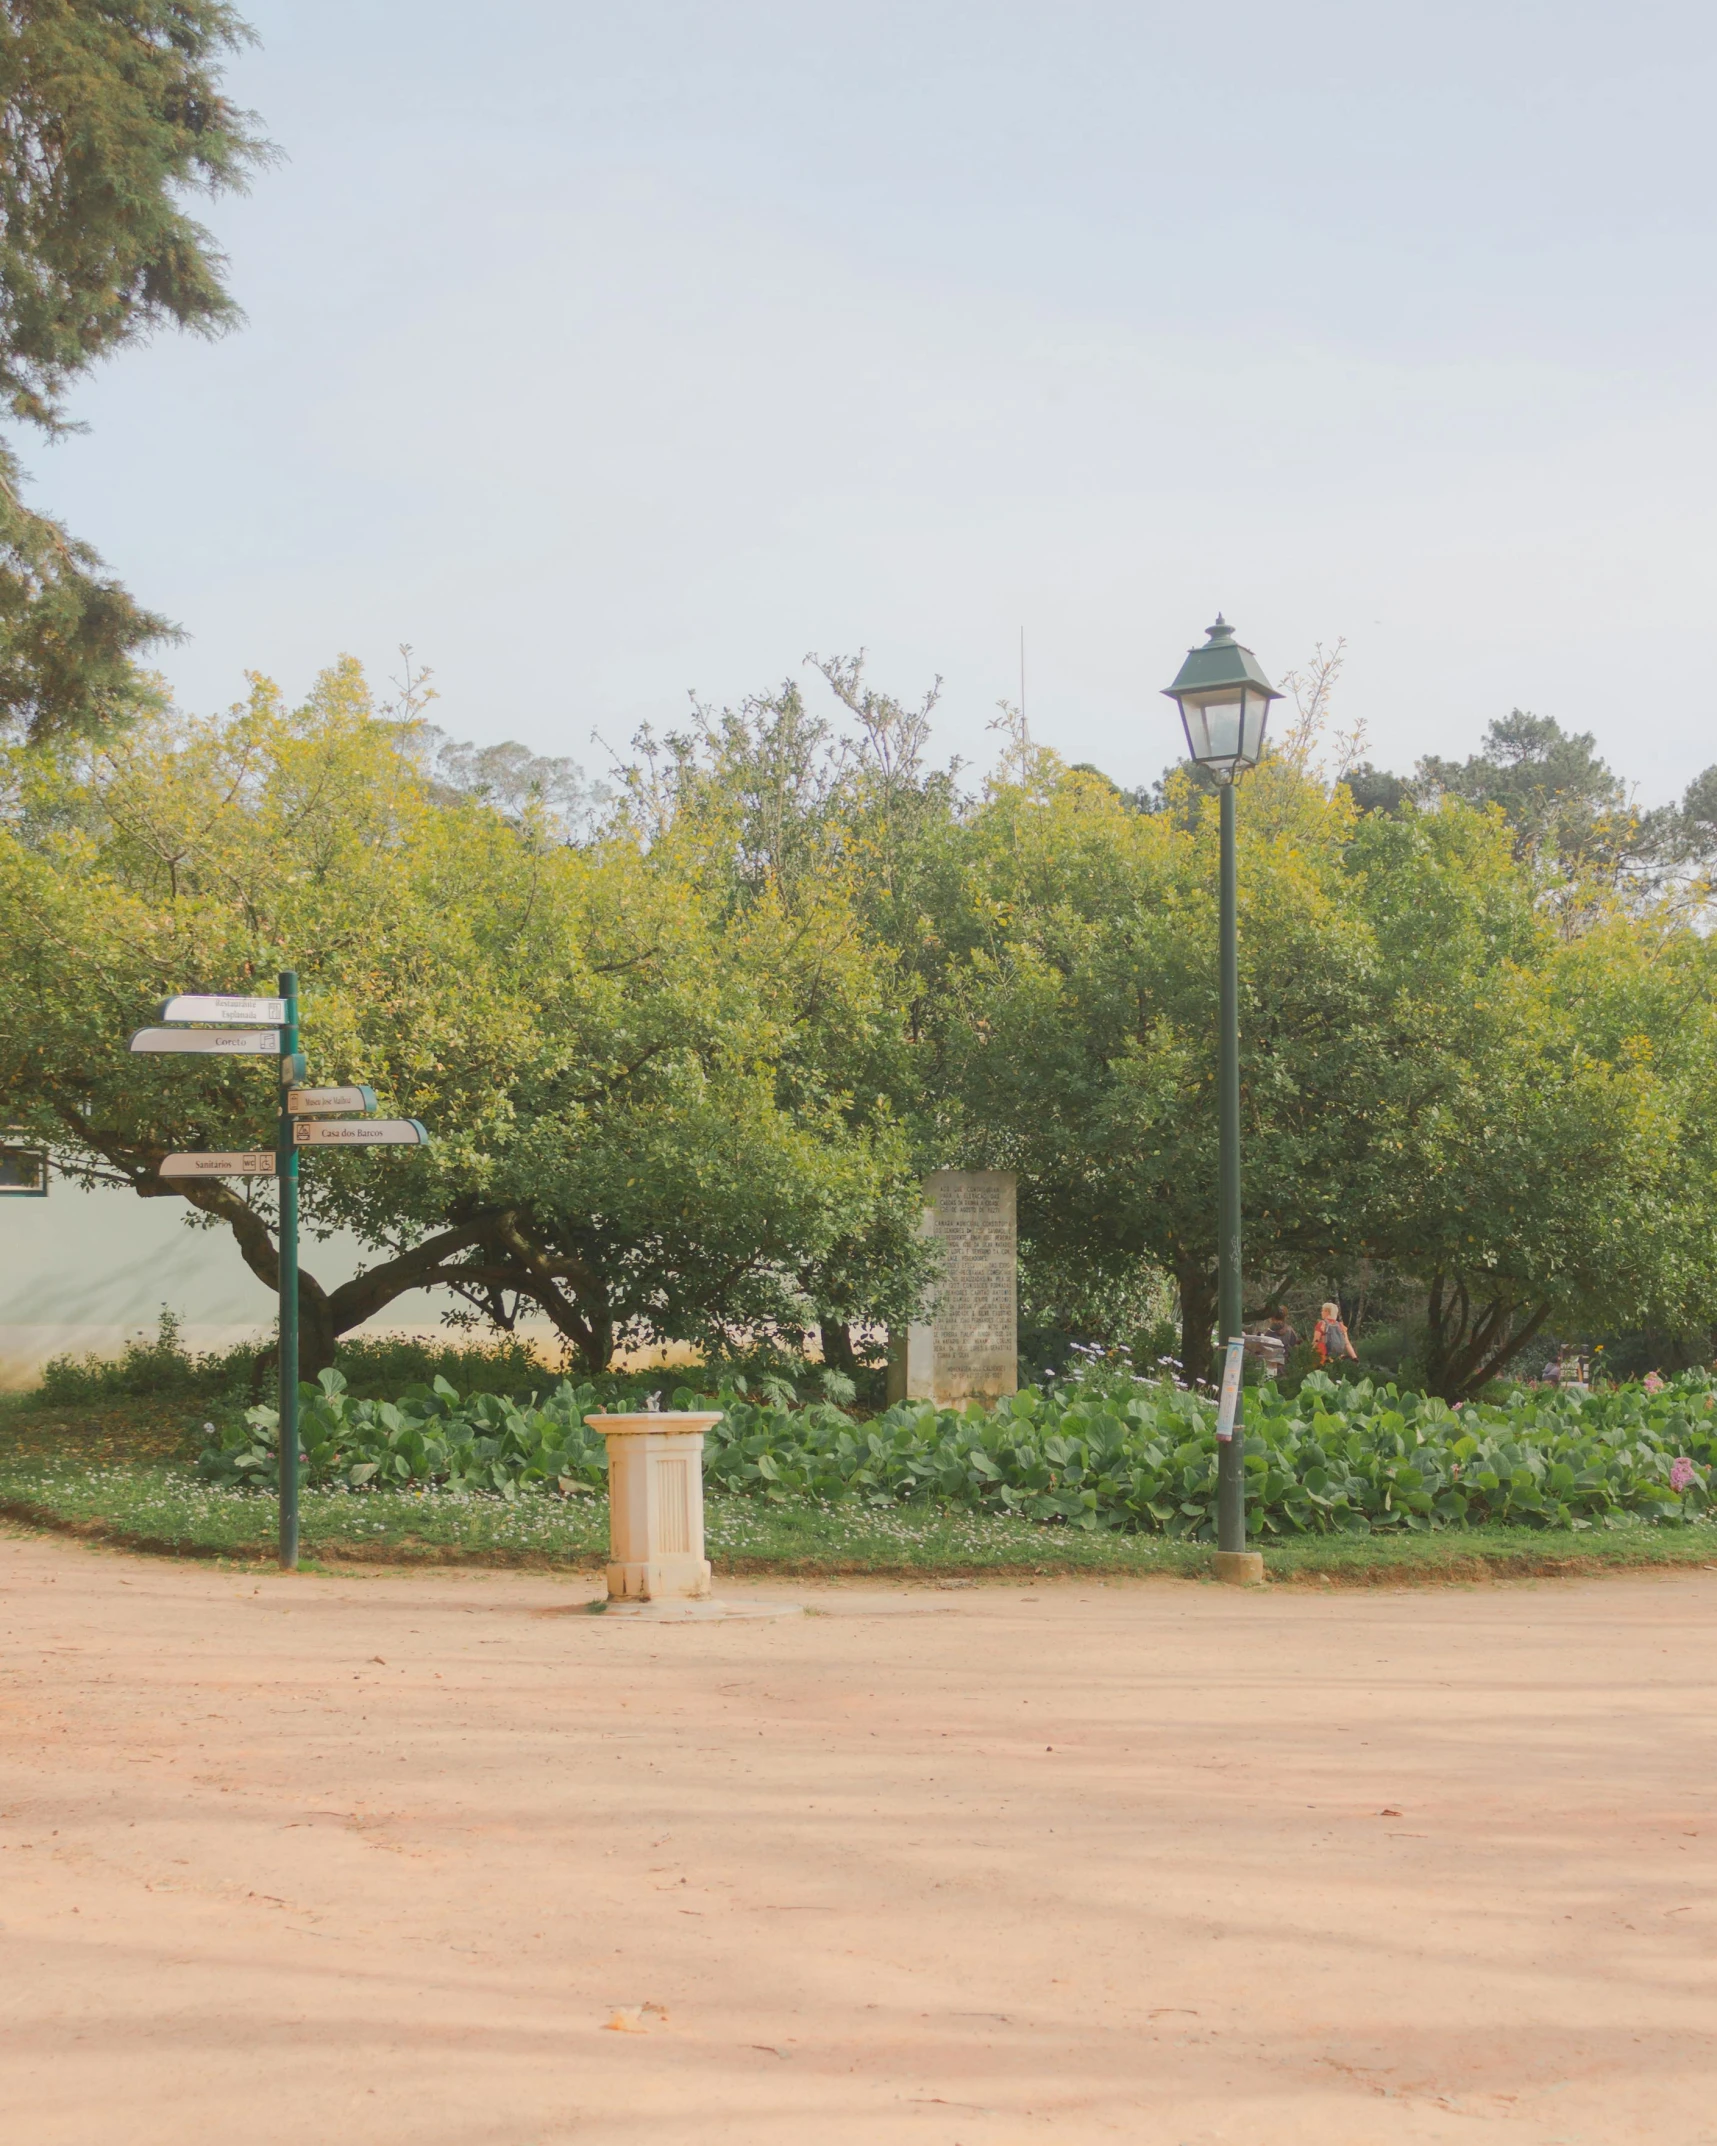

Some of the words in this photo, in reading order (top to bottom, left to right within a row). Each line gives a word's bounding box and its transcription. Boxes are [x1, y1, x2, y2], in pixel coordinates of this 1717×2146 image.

[215, 999, 257, 1008] Restaurante
[221, 1010, 257, 1020] Esplanada
[215, 1037, 247, 1046] Coreto
[321, 1129, 340, 1138] Casa
[341, 1129, 356, 1138] dos
[357, 1129, 384, 1138] Barcos
